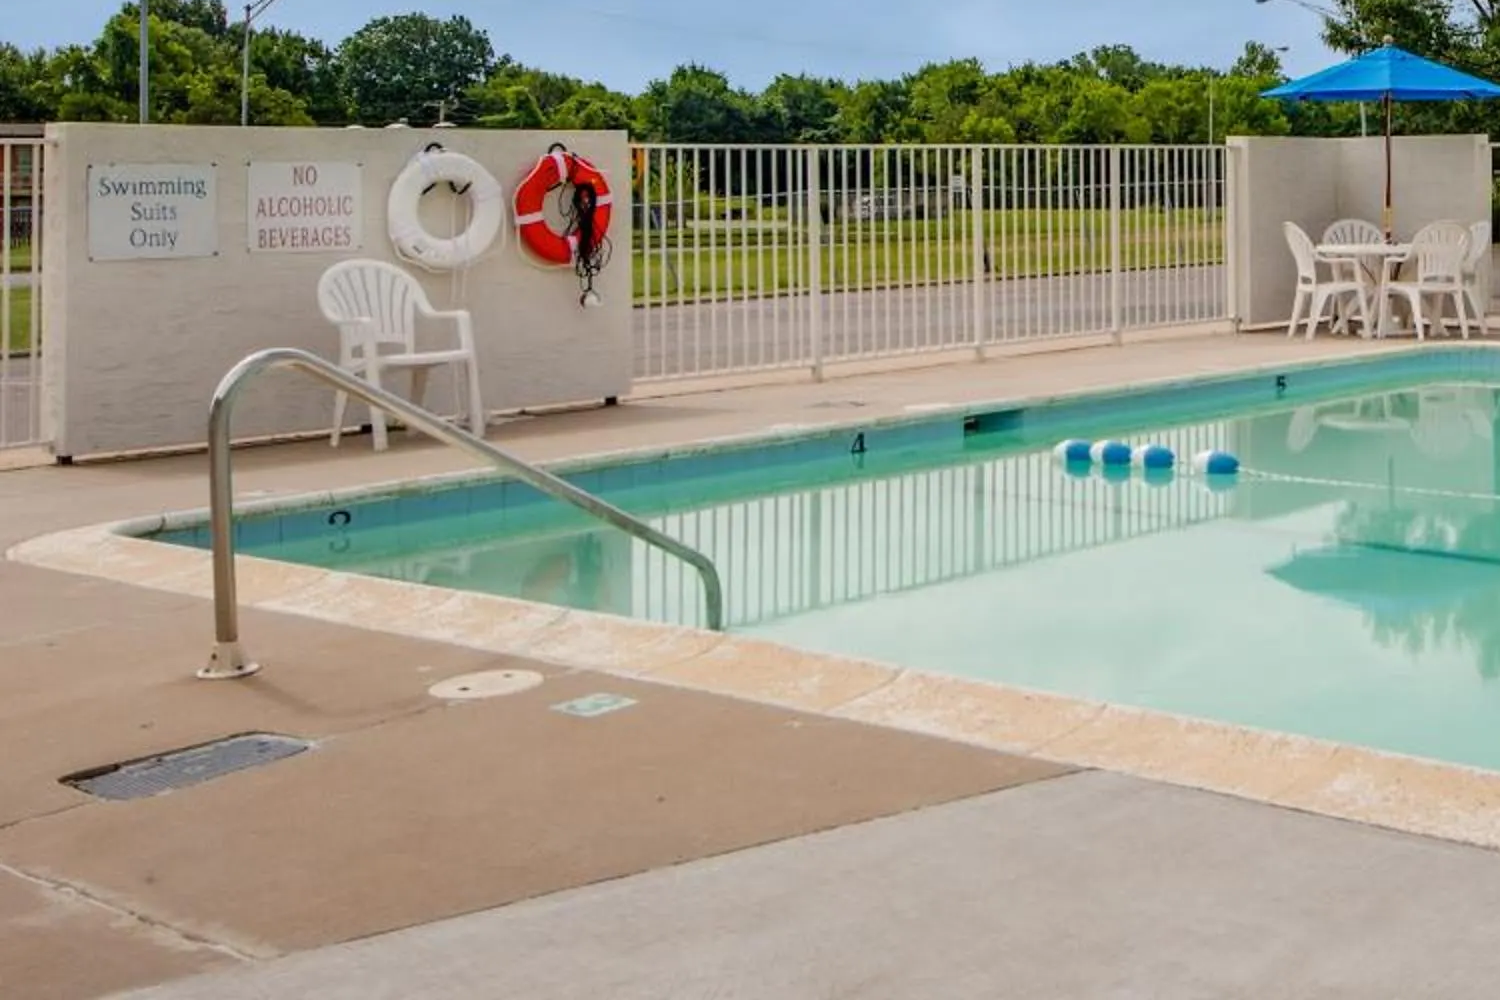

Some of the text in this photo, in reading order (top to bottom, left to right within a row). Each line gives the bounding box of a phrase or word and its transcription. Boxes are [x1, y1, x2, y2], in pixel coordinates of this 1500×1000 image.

[292, 165, 318, 187] NO
[99, 176, 208, 199] Swimming
[130, 201, 178, 222] Suits
[256, 195, 353, 218] ALCOHOLIC
[129, 228, 179, 250] Only
[257, 227, 352, 249] BEVERAGES
